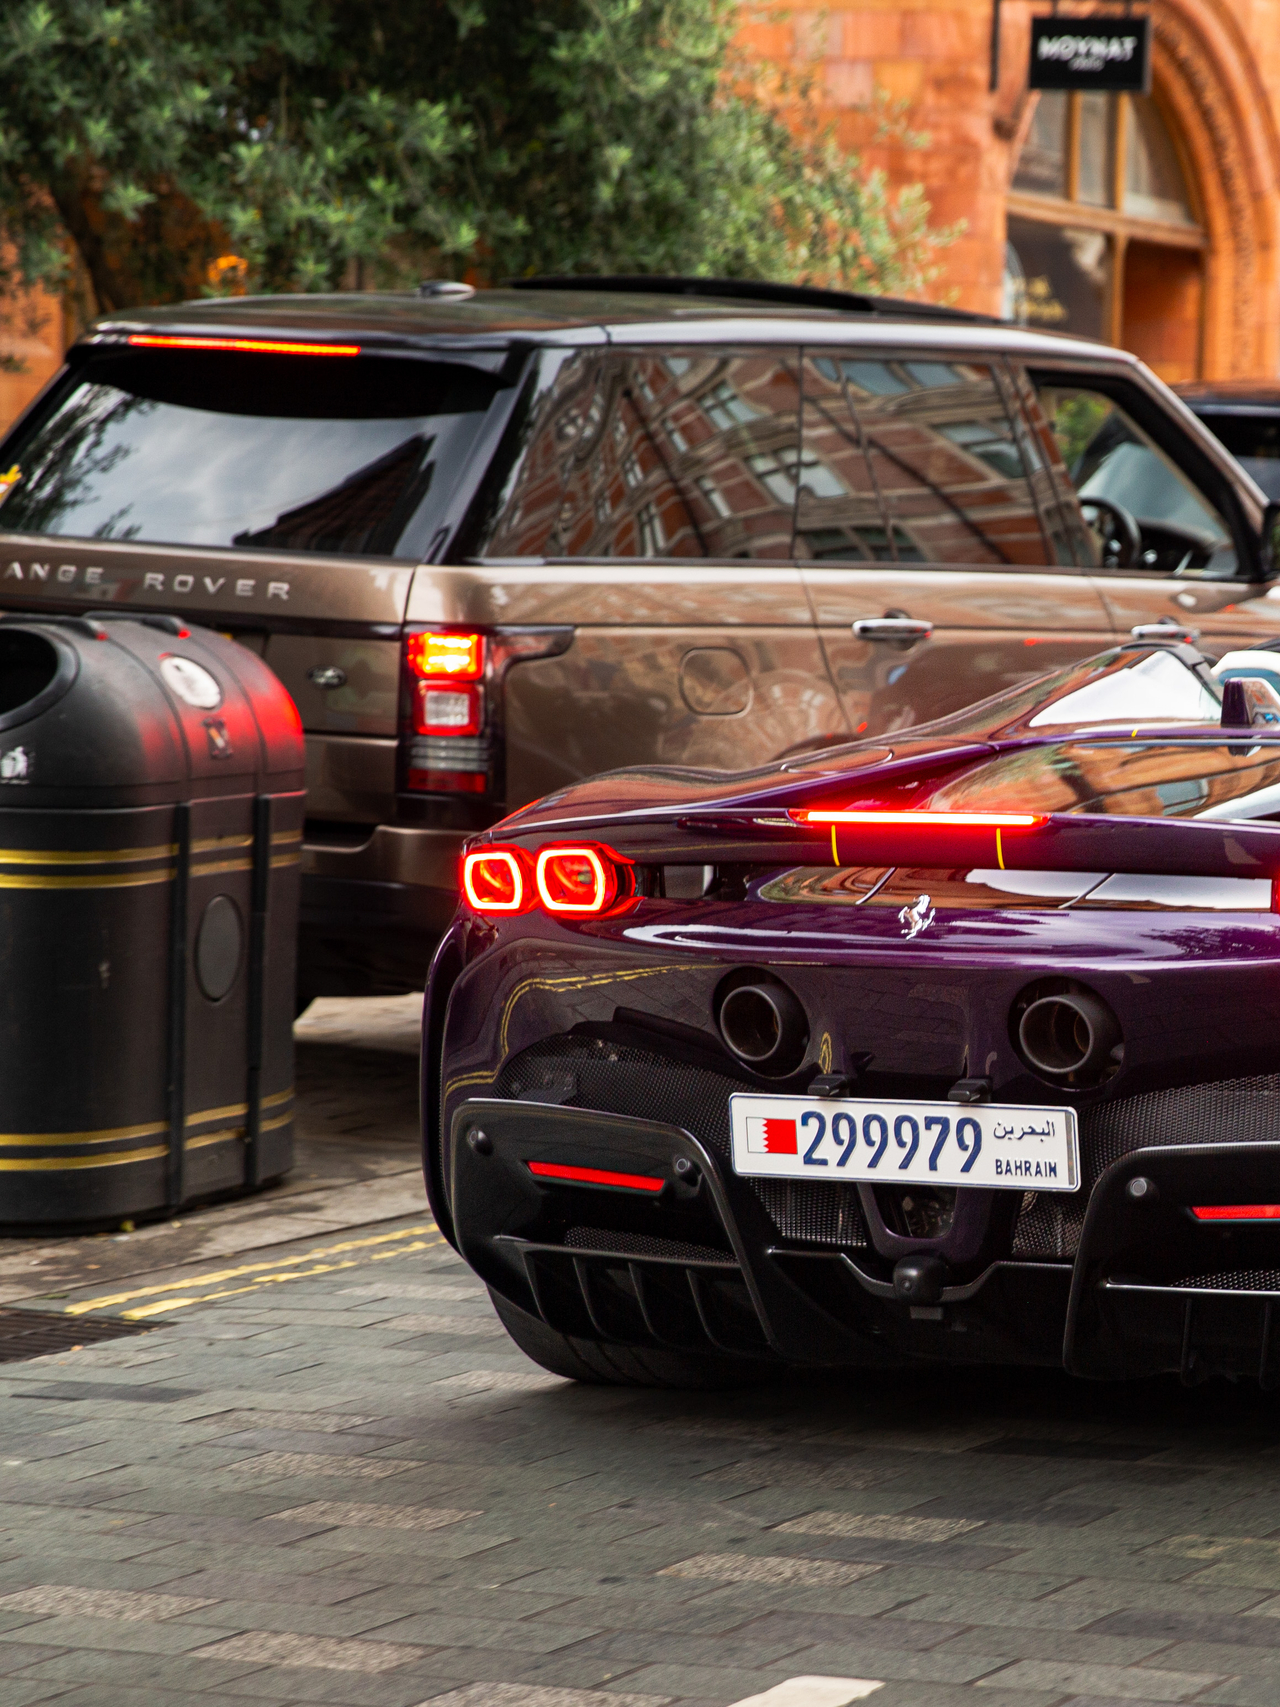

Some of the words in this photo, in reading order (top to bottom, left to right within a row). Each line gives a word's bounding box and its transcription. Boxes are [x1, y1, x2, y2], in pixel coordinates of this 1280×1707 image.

[1038, 35, 1137, 61] MOYNAT
[144, 572, 290, 600] ROVER
[800, 1110, 984, 1174] 299979
[993, 1119, 1056, 1143] البحرين
[995, 1158, 1058, 1179] BAHRAIN
